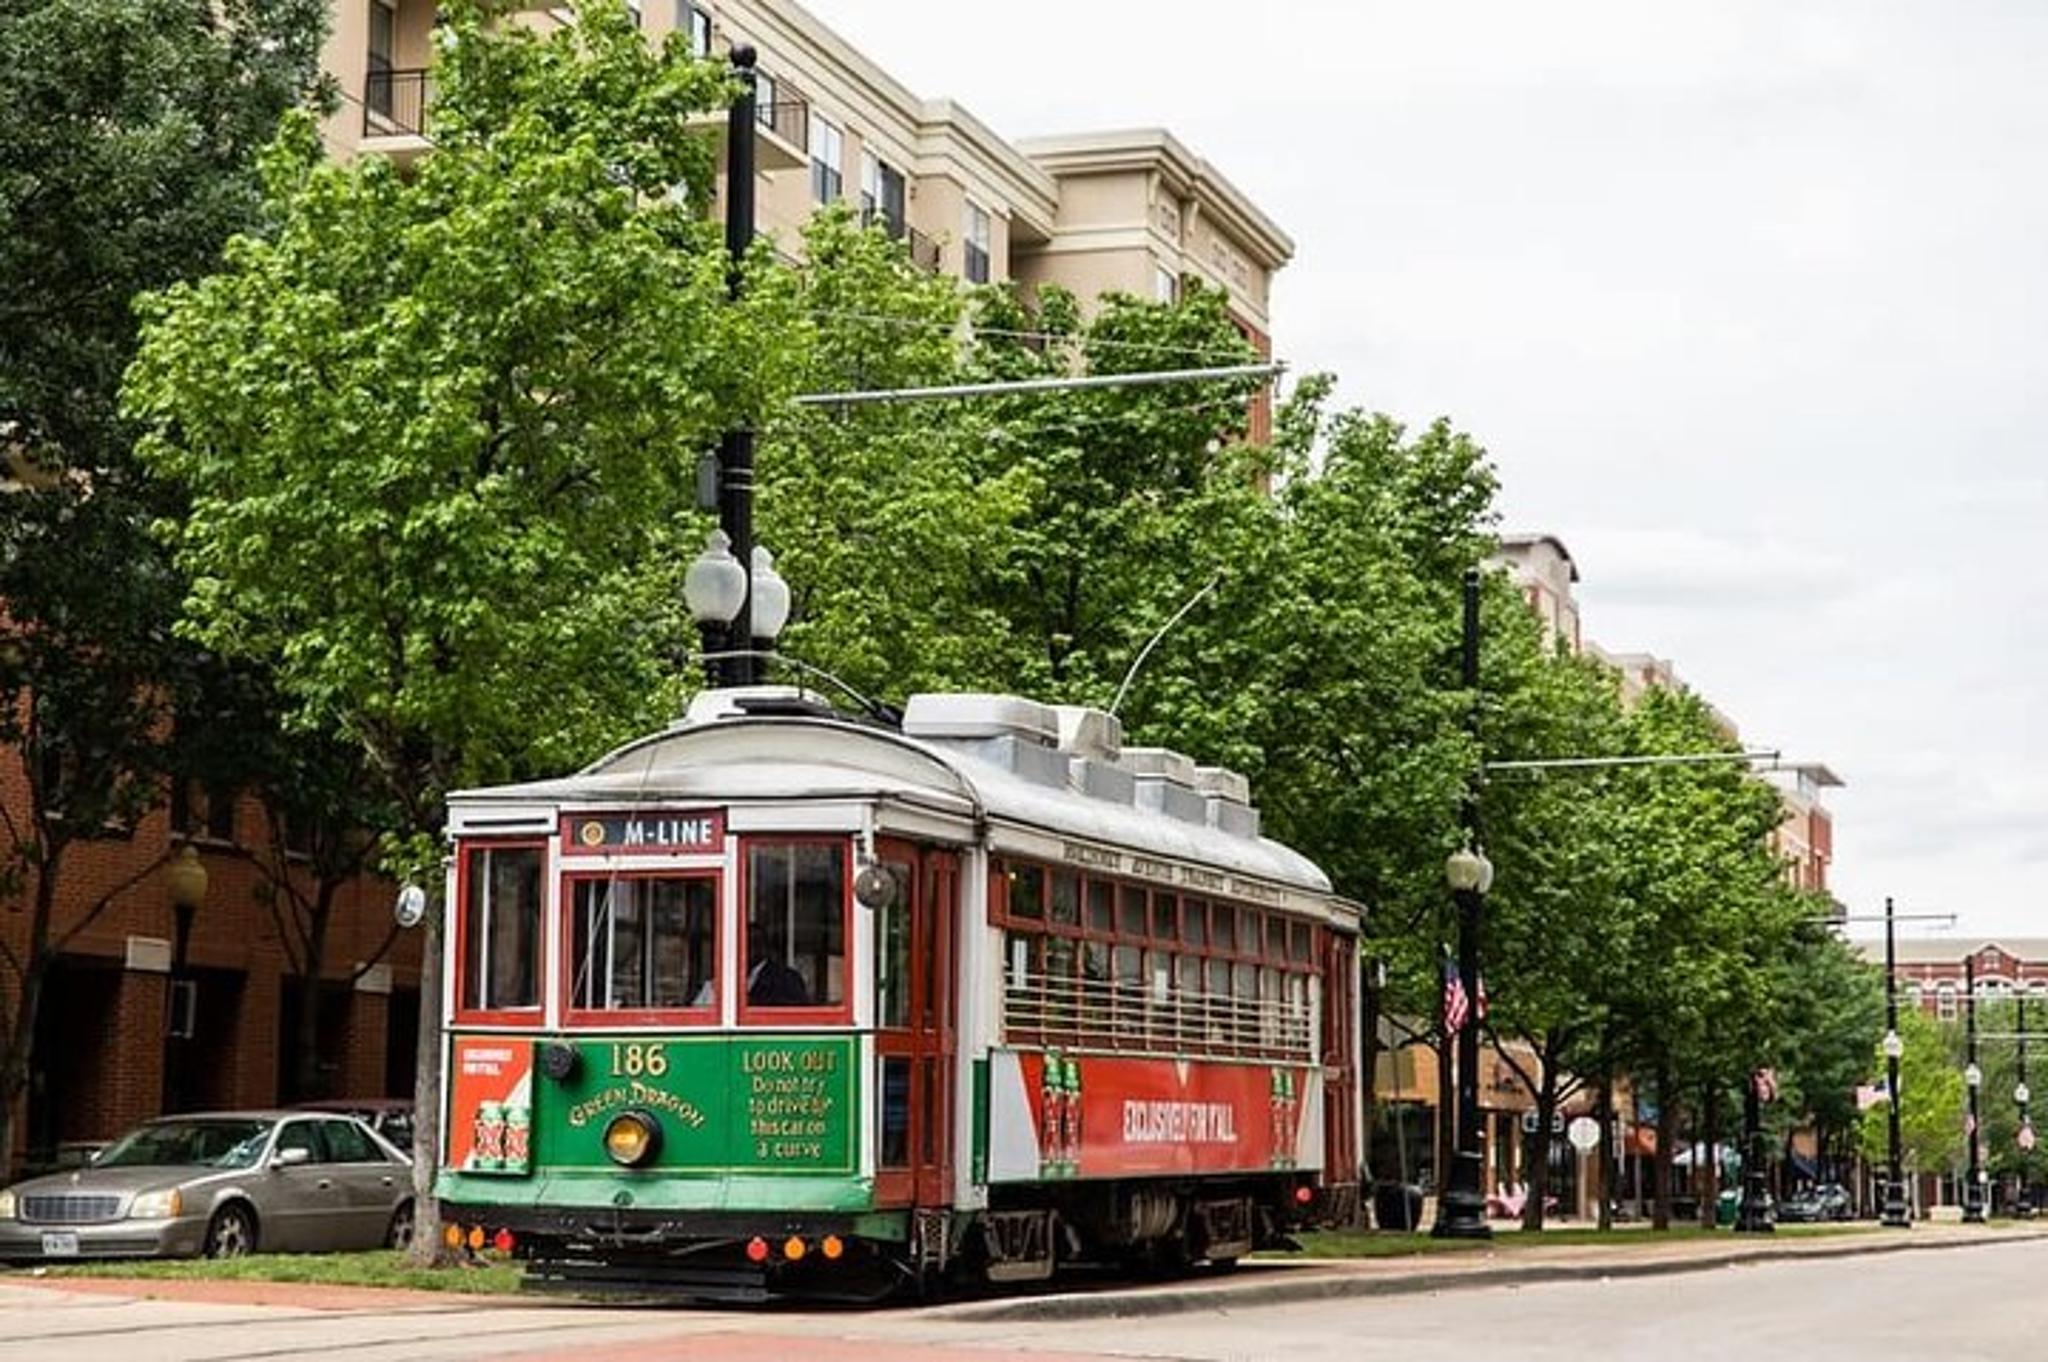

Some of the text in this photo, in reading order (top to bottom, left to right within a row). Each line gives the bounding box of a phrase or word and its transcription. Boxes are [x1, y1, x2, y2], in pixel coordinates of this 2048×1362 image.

[624, 820, 713, 846] M-LINE
[609, 1043, 667, 1076] 186
[742, 1050, 795, 1073] LOOK
